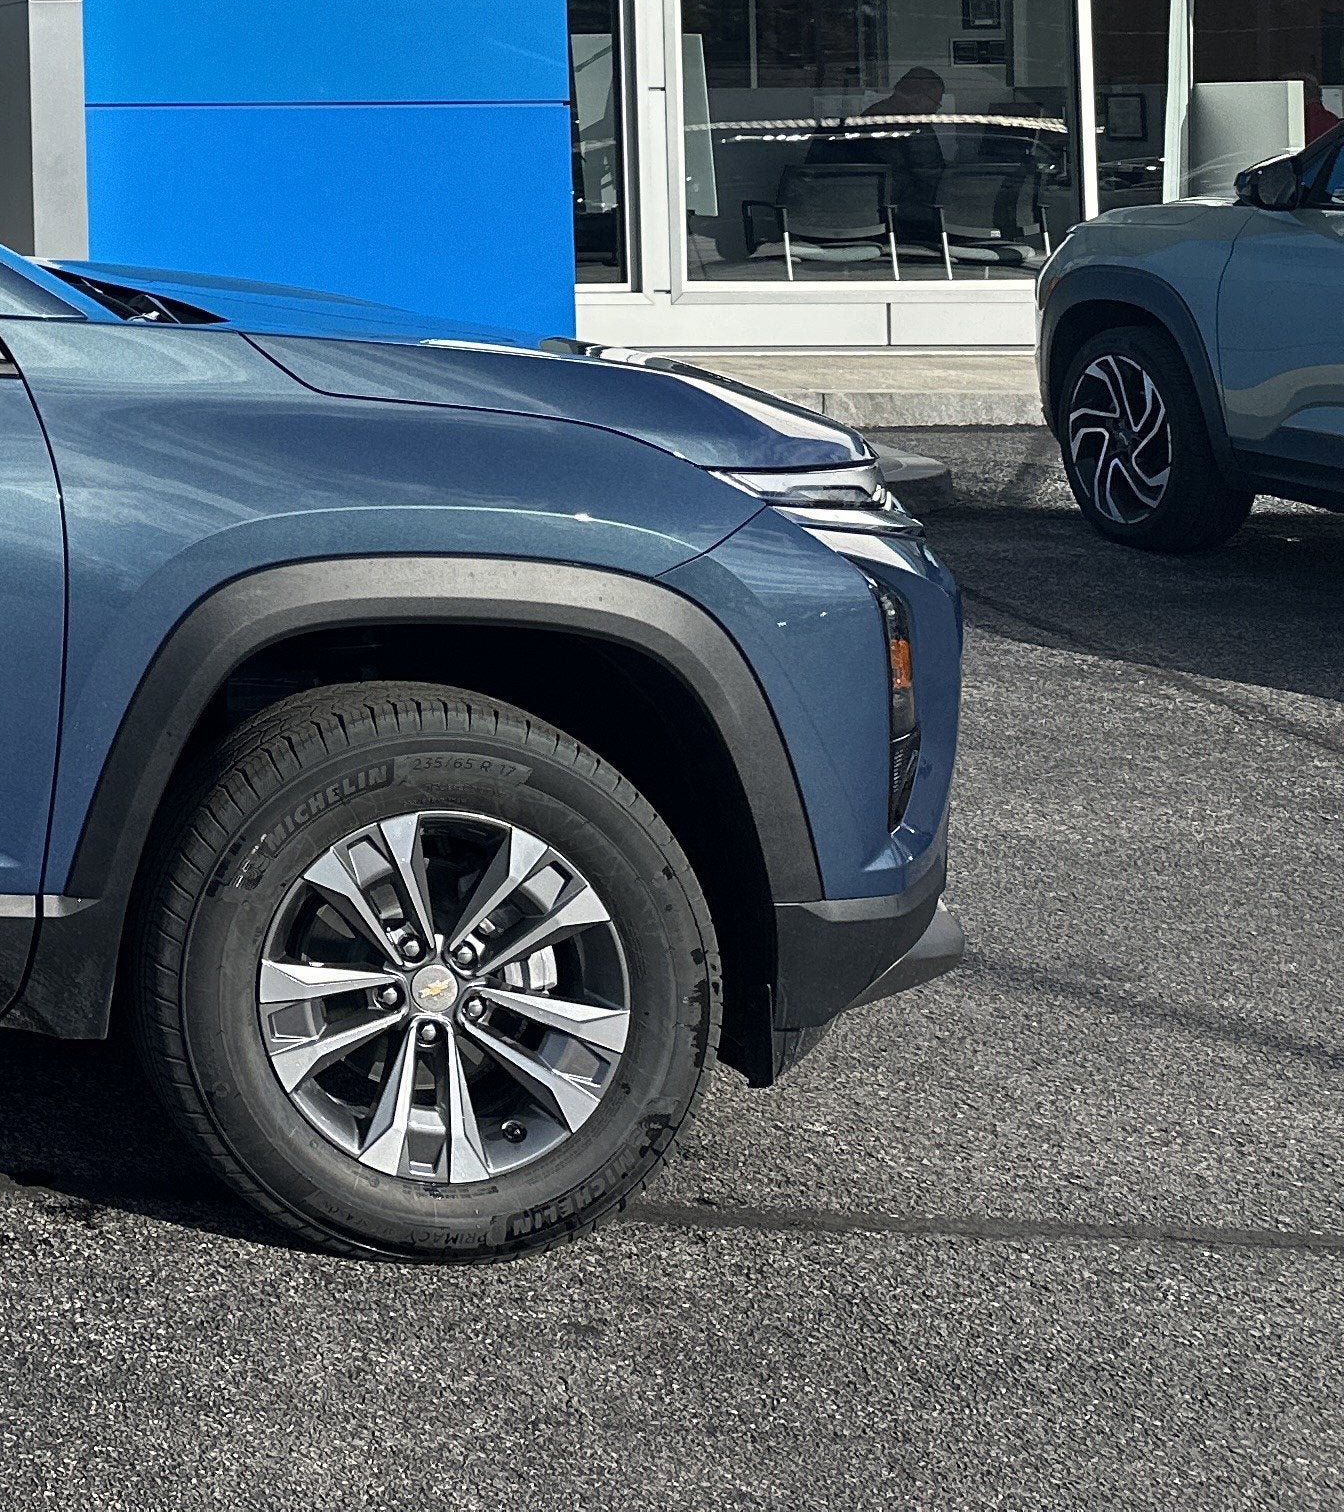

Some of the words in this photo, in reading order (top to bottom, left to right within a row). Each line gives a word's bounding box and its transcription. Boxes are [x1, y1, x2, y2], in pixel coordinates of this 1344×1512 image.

[265, 763, 388, 852] MICHELIN
[412, 757, 474, 773] 235/65
[512, 1147, 638, 1239] MICHELIN
